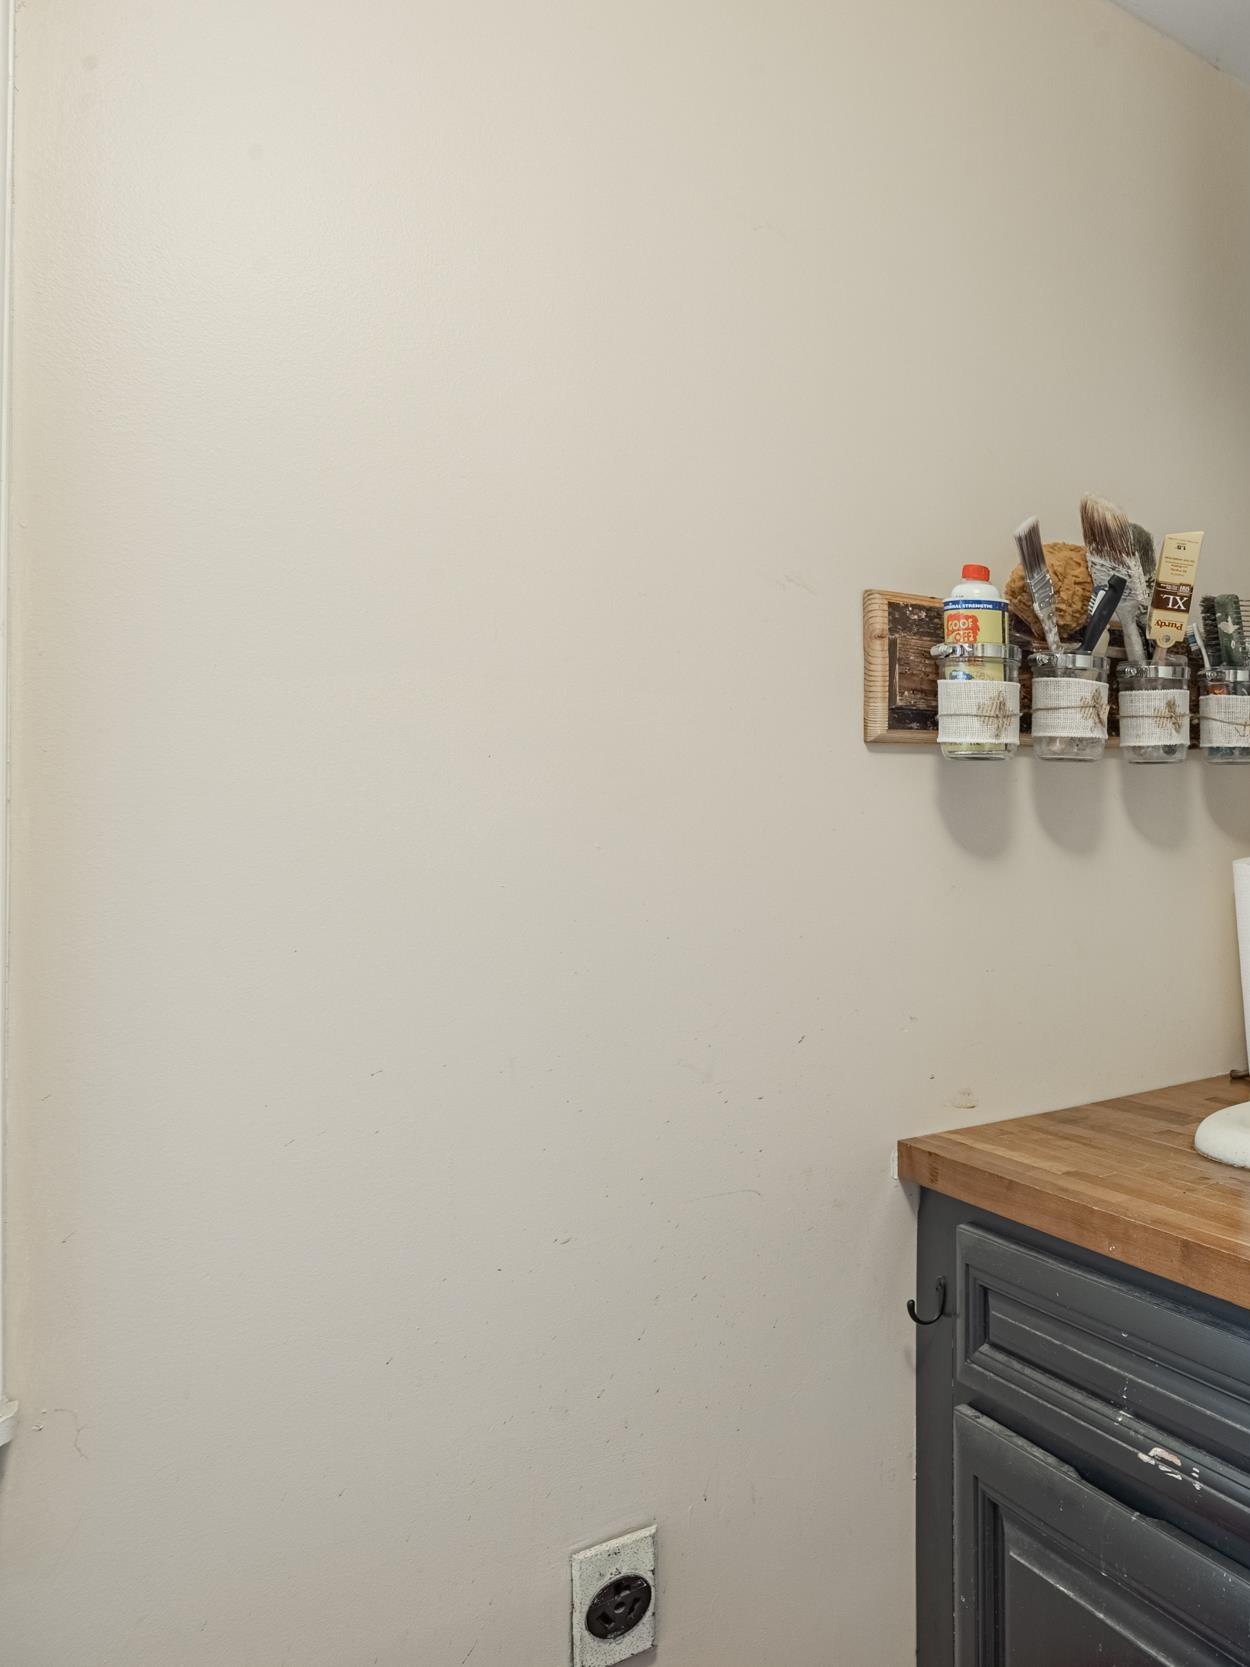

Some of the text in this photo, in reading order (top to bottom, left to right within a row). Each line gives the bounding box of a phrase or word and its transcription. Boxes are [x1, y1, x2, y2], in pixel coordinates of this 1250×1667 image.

[1162, 594, 1188, 610] XL
[948, 618, 973, 630] GOOF
[1154, 618, 1184, 631] Purdy
